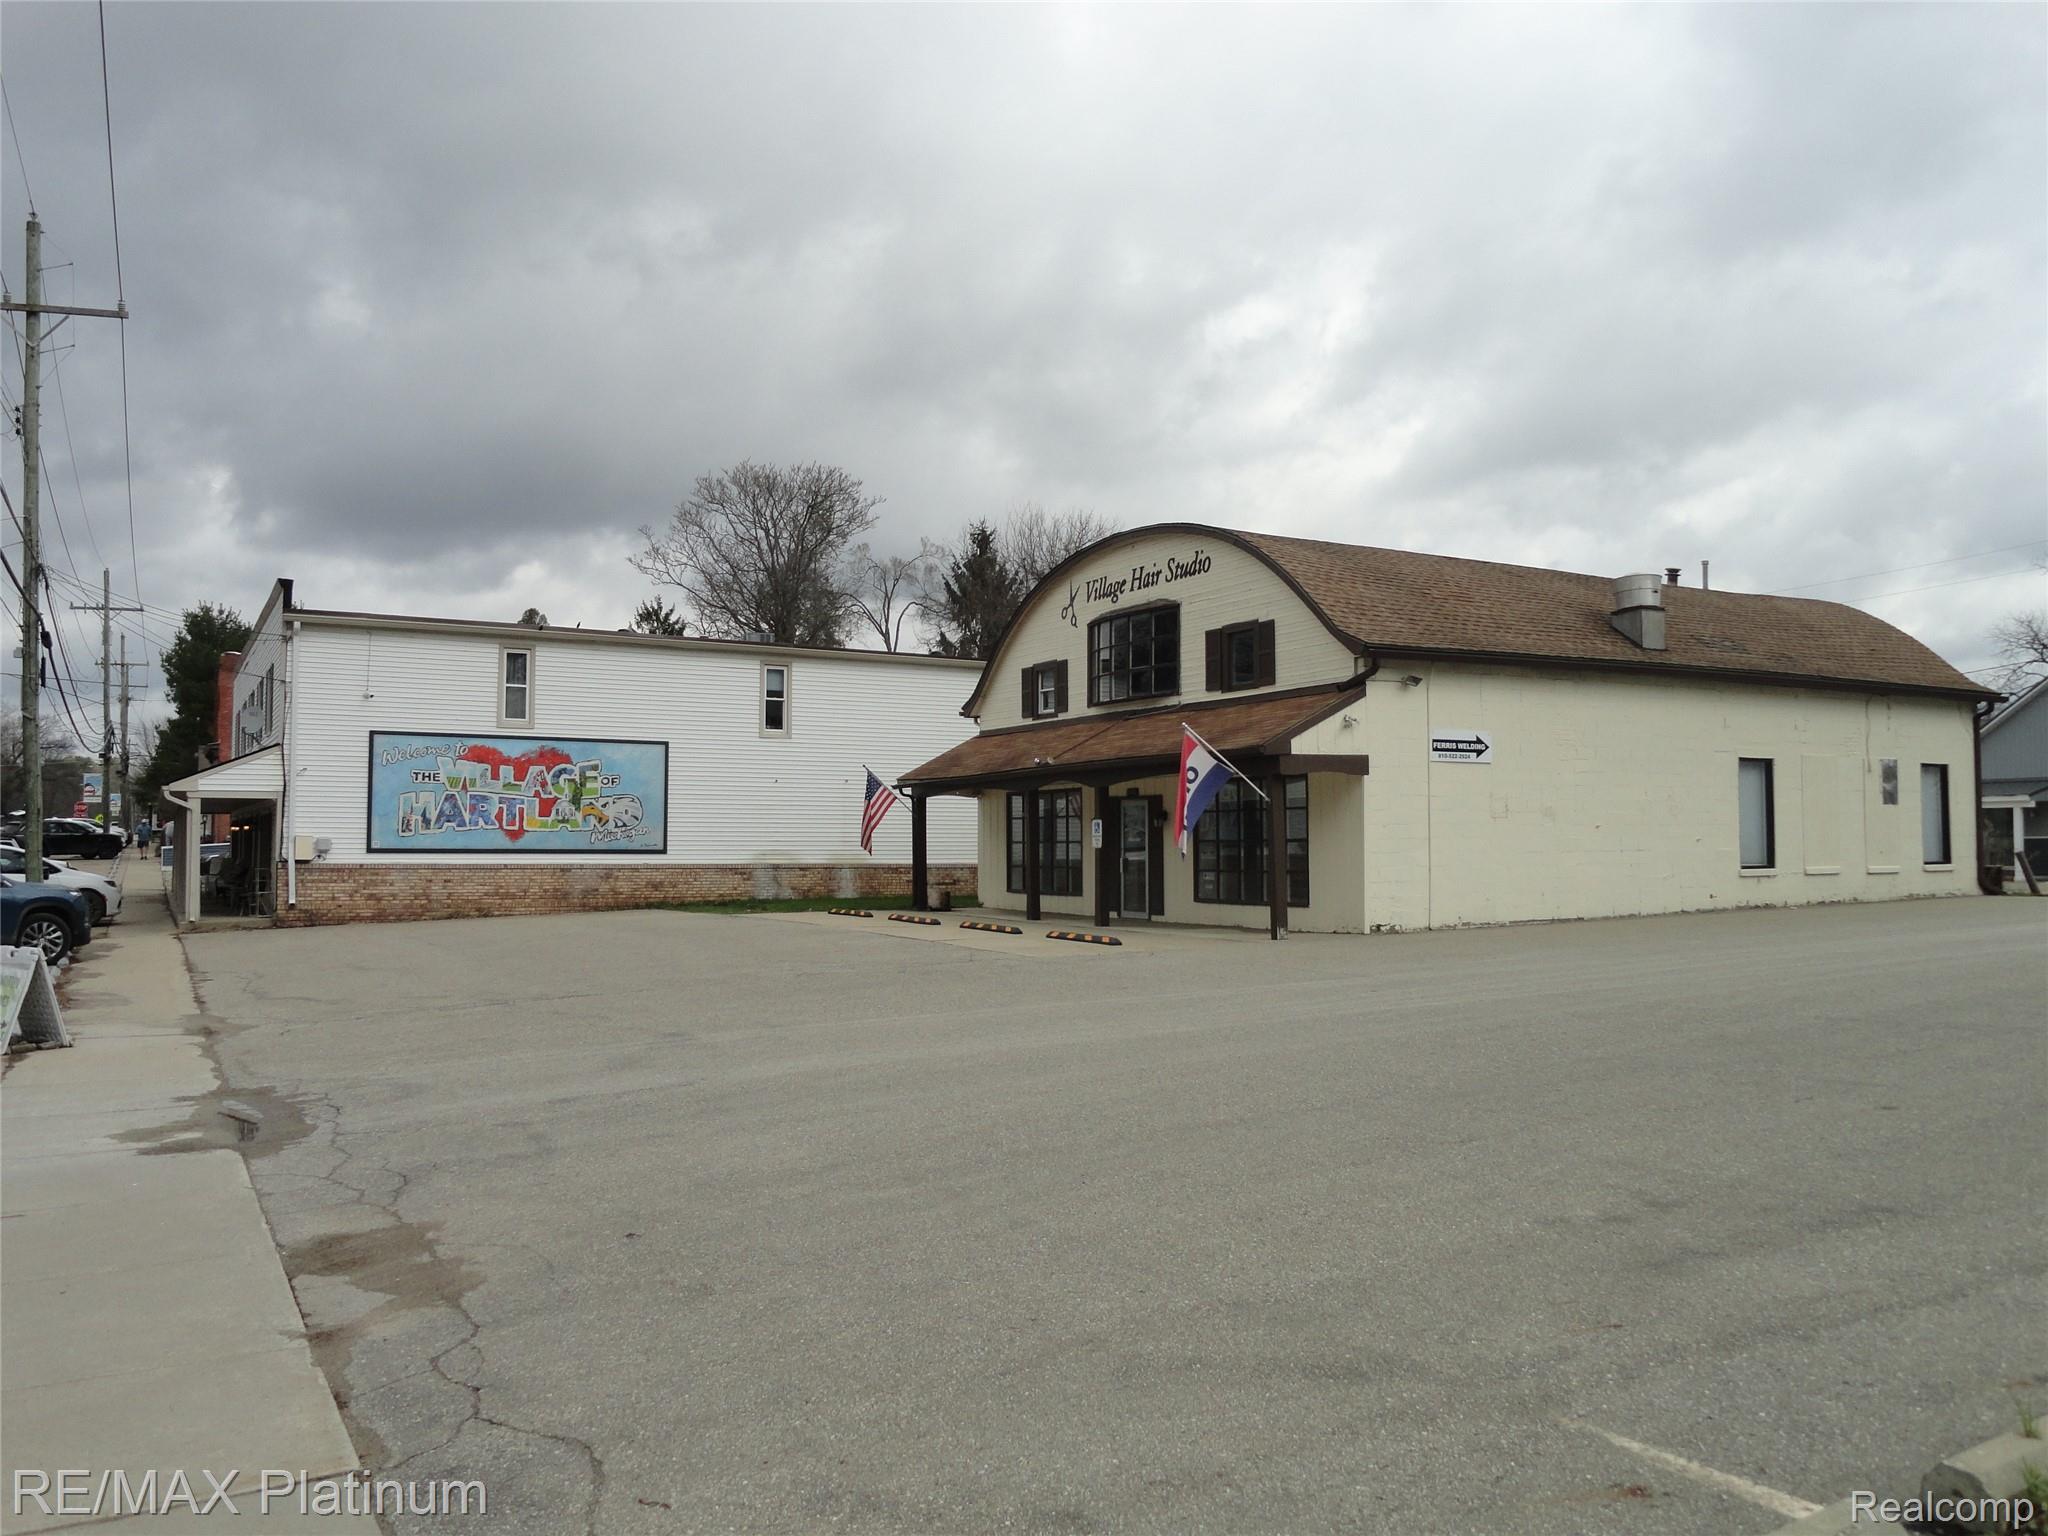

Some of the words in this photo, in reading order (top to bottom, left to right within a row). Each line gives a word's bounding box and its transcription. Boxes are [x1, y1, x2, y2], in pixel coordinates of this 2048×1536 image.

[1086, 576, 1127, 604] Village
[1129, 563, 1162, 592] Hair
[1165, 550, 1212, 583] Studio
[382, 744, 450, 767] Welcome
[454, 741, 469, 757] to
[412, 771, 441, 782] THE
[437, 756, 602, 799] VILLAGE
[600, 776, 619, 787] OF
[397, 791, 644, 837] HARTLAND
[590, 826, 650, 844] Michigan
